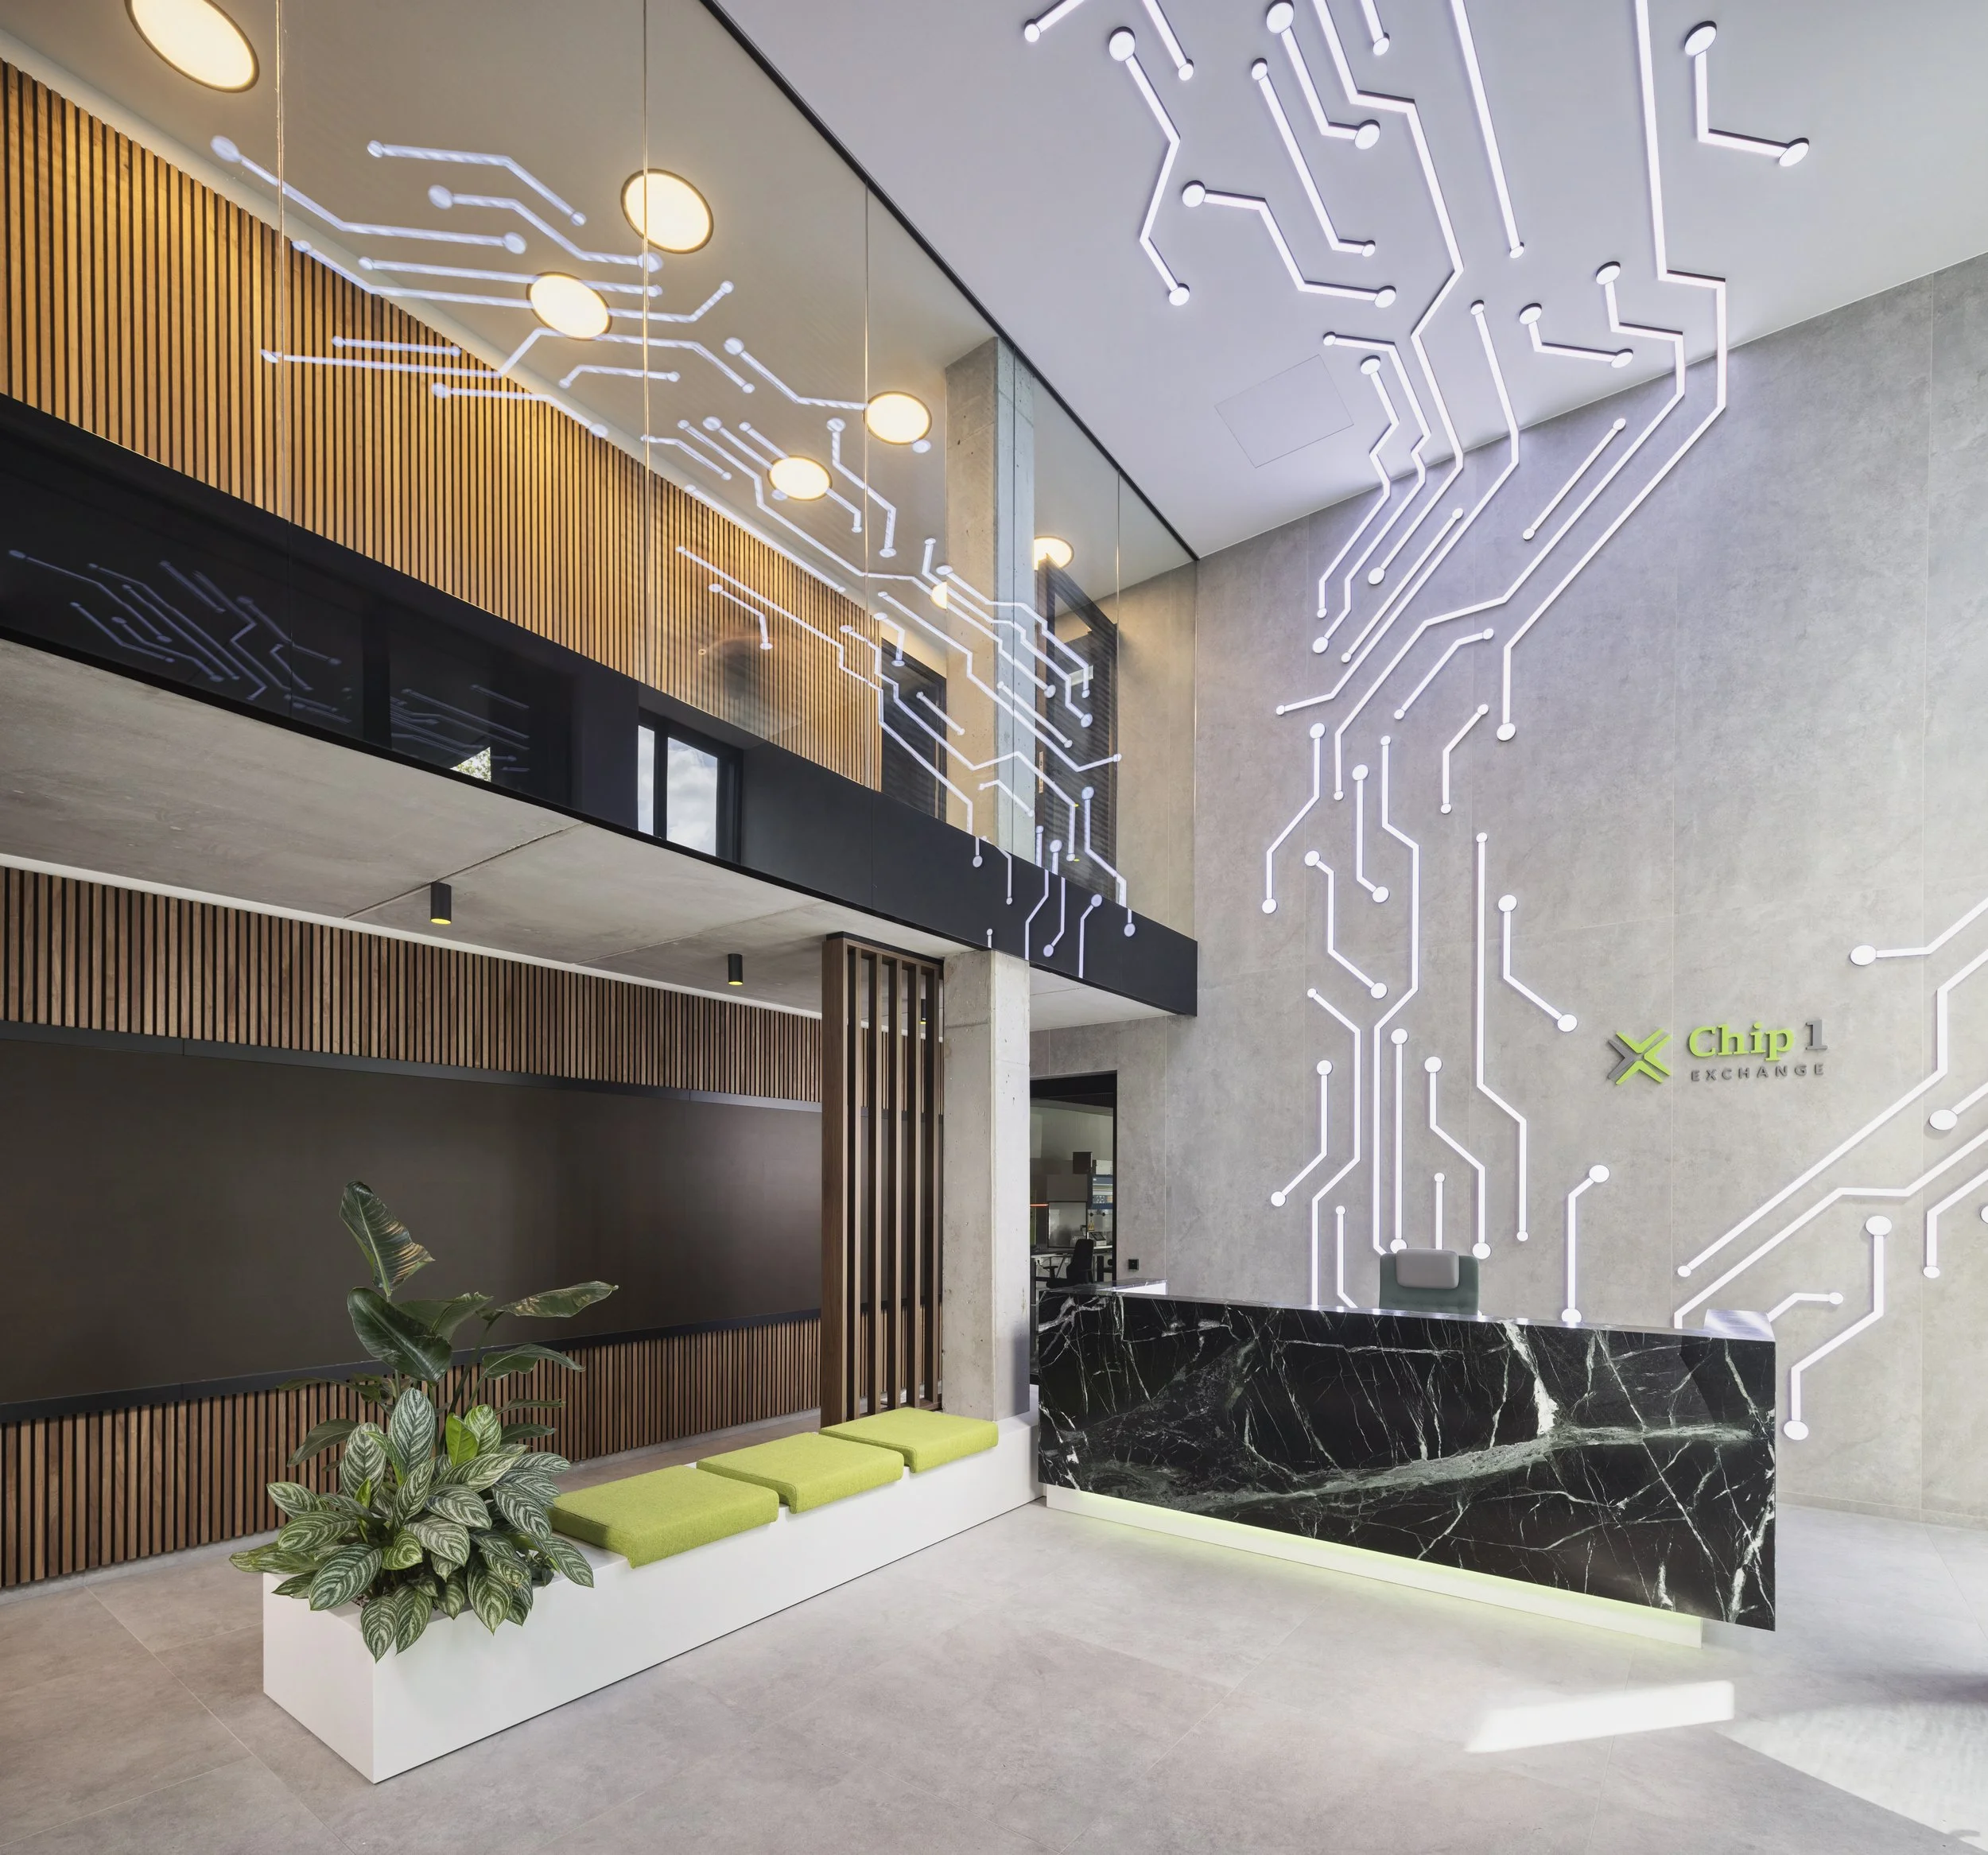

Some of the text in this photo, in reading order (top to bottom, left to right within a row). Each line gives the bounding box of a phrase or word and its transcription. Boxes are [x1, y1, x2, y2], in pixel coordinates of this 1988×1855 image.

[1688, 1019, 1827, 1061] Chip 1
[1691, 1063, 1824, 1081] EXCHANGE
